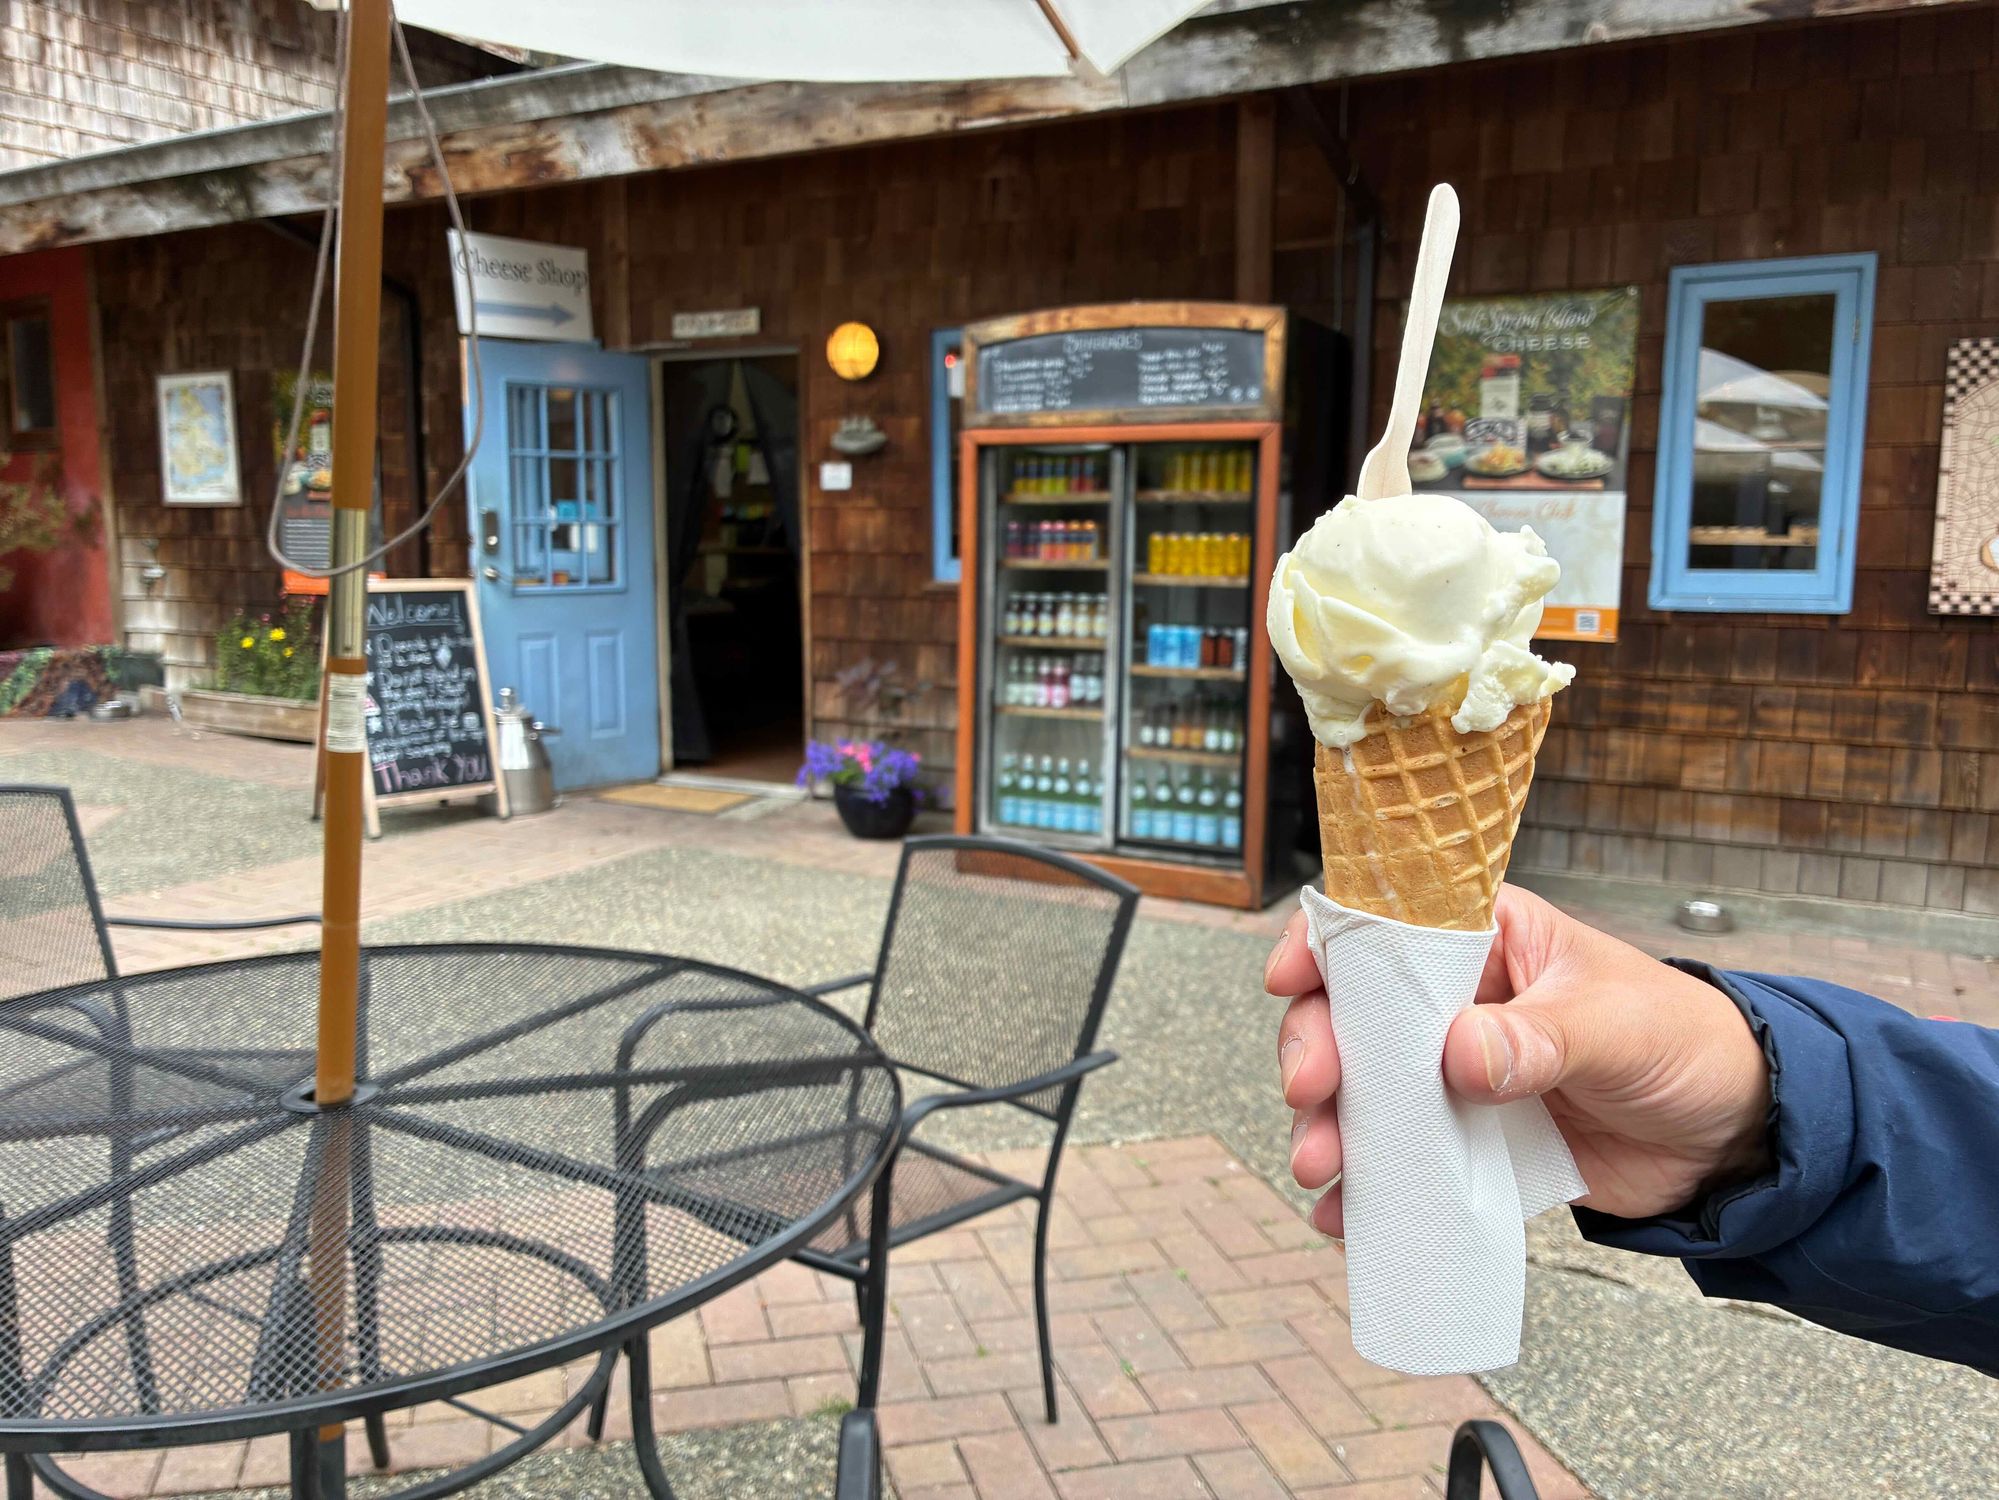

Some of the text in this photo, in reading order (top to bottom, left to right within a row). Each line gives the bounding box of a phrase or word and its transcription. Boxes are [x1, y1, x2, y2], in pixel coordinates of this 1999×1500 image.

[454, 248, 588, 296] Cheese Shop
[1492, 332, 1593, 352] CHEESE
